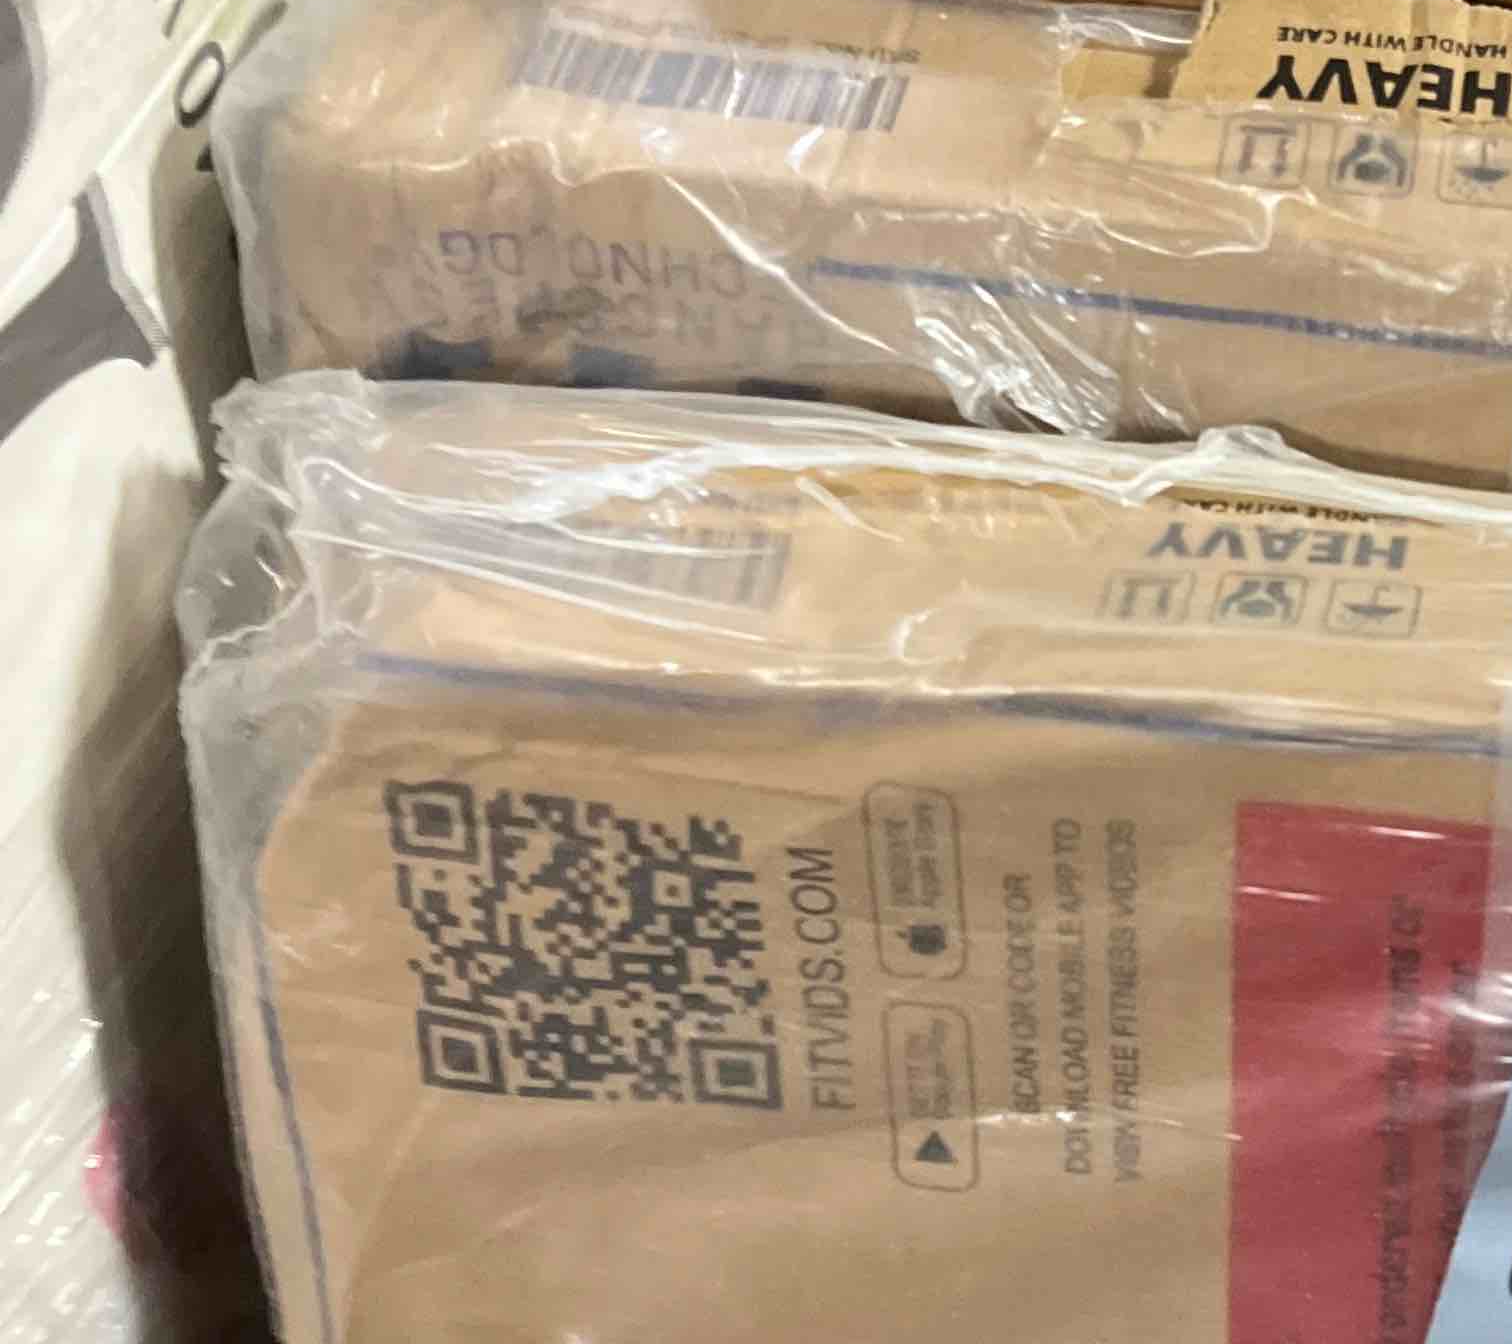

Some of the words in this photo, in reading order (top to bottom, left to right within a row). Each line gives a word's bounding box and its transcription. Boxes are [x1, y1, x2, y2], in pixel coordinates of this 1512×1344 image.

[1276, 25, 1337, 45] CARE
[1343, 32, 1407, 52] WITH
[1410, 35, 1509, 59] HANDLE
[1256, 55, 1512, 118] HEAVY
[1147, 522, 1411, 571] HEAVY
[1052, 818, 1082, 857] TO
[1003, 873, 1032, 913] OR
[786, 847, 856, 1112] FITVIDS.COM
[1108, 927, 1140, 1039] FITNESS
[1009, 1047, 1040, 1113] SCAN
[1110, 1046, 1141, 1112] FREE
